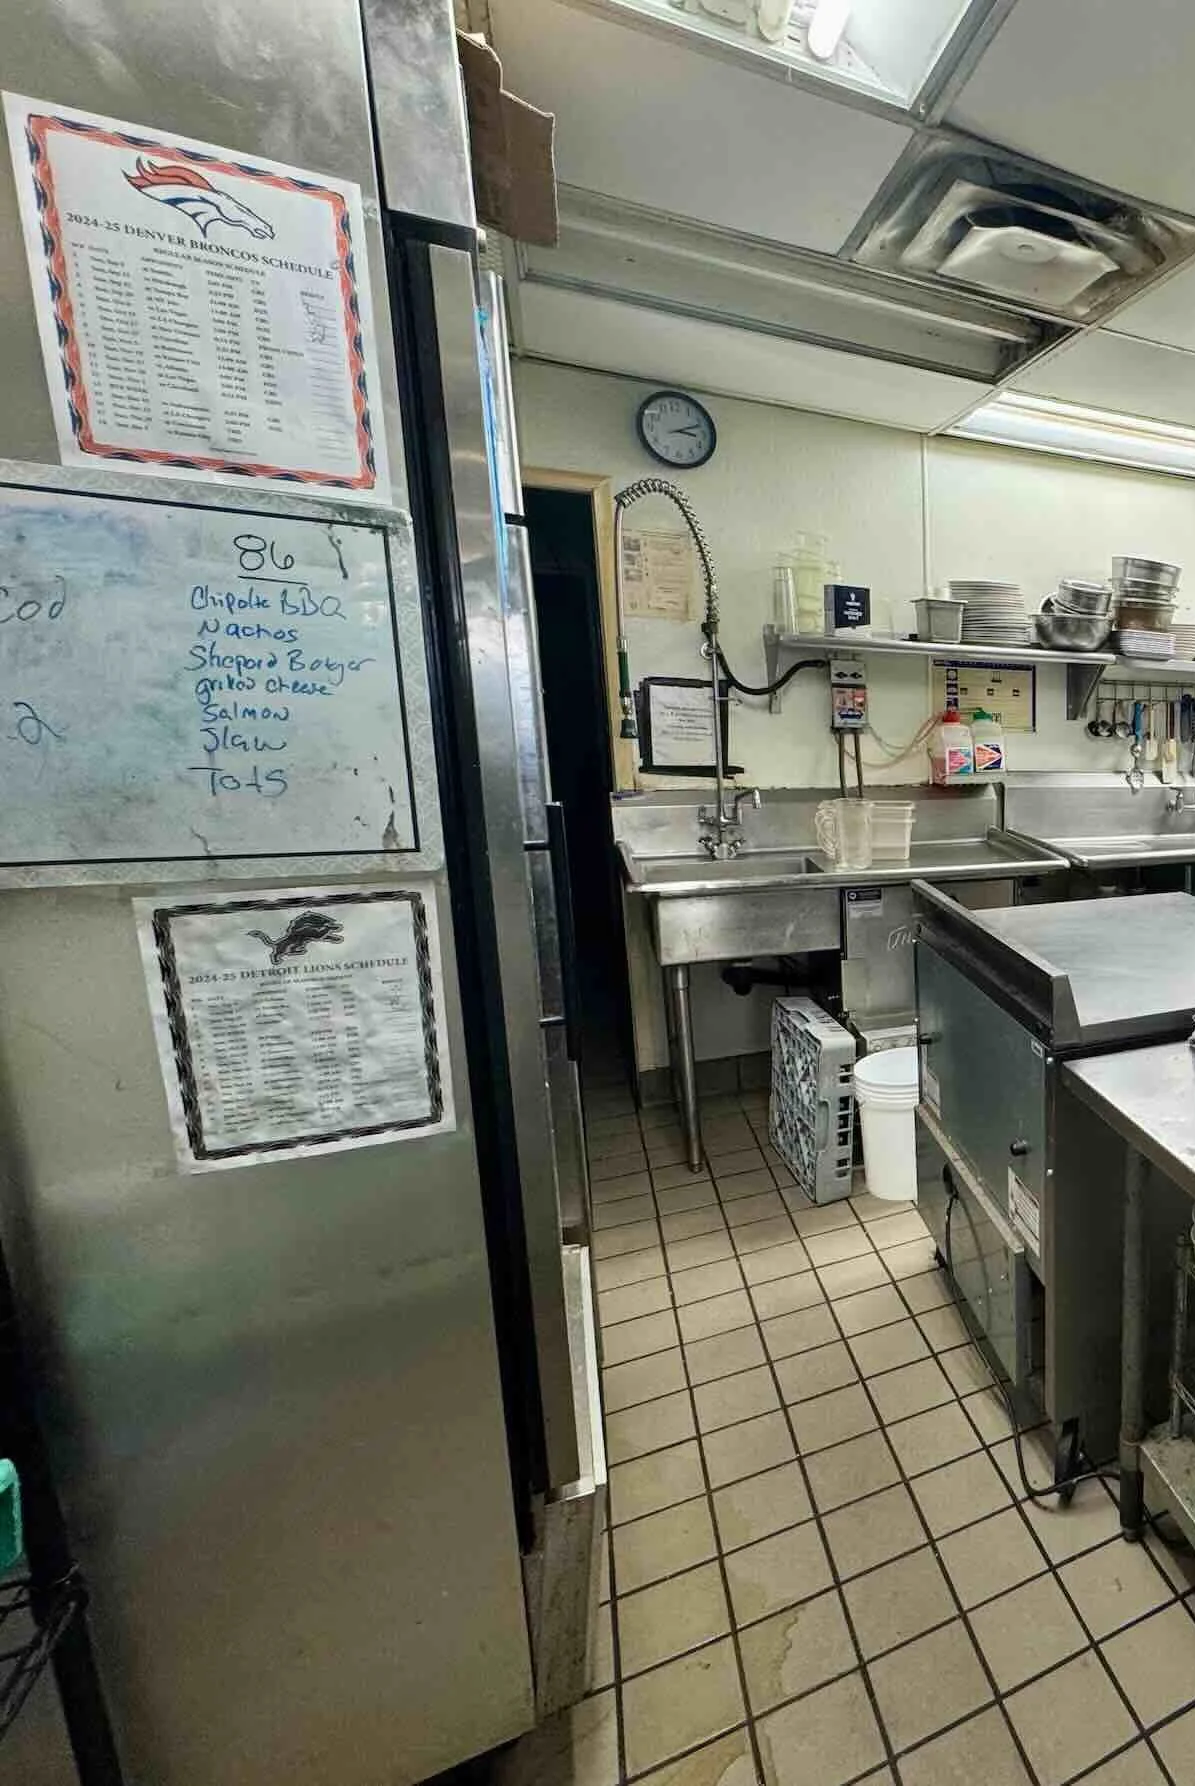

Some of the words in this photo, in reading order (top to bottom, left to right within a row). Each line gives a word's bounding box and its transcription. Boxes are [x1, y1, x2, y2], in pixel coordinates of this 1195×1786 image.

[65, 212, 121, 232] 2024-25
[124, 224, 186, 247] DENVER
[190, 239, 260, 263] BRONCOS
[261, 256, 334, 280] SCHEDULE
[233, 534, 295, 571] 86
[197, 618, 298, 643] Nachos
[202, 702, 289, 722] Salmon
[200, 726, 287, 752] Slaw
[187, 766, 288, 797] Tots
[240, 966, 299, 981] DETROIT
[303, 963, 342, 975] LIONS
[343, 957, 409, 972] SCHEDULE
